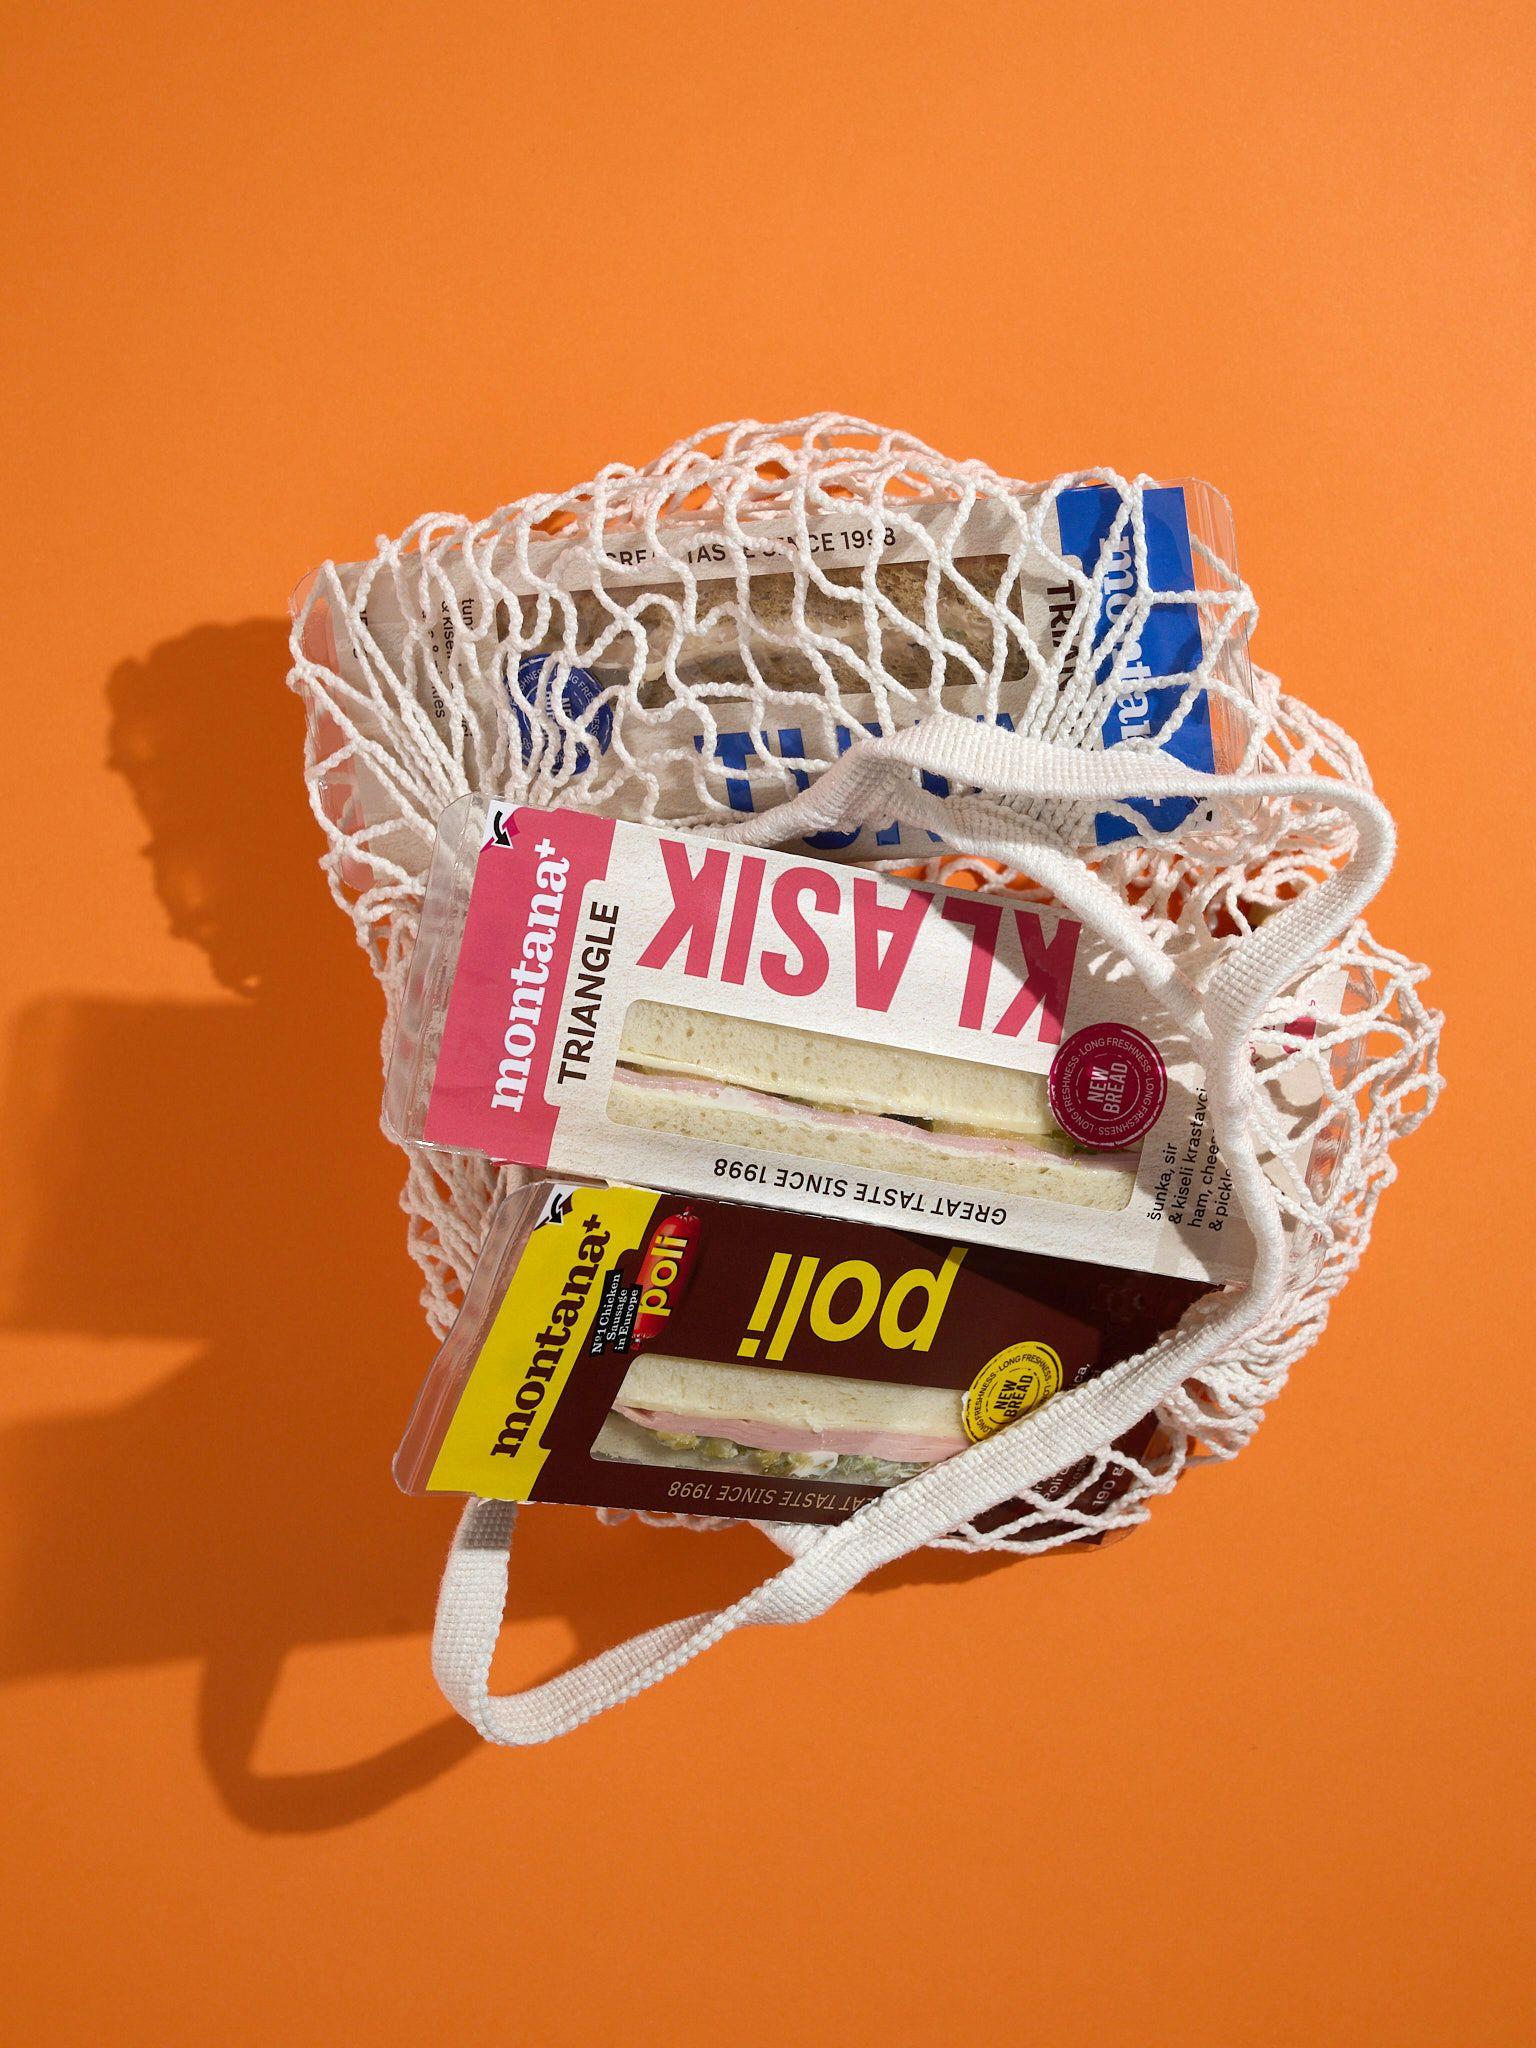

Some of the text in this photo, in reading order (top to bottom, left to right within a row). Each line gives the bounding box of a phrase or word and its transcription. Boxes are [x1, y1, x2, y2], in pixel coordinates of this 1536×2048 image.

[461, 598, 475, 634] tun
[635, 838, 1082, 1045] KLASIK
[557, 901, 619, 1084] TRIANGLE
[1079, 1037, 1152, 1073] LONG FRESHNESS
[1061, 1055, 1095, 1133] LONG FRESHNESS
[1087, 1066, 1109, 1103] NEW
[1098, 1077, 1155, 1136] LONG FRESHNESS
[1103, 1062, 1128, 1115] BREAD
[1163, 1142, 1178, 1165] sir
[1168, 1087, 1208, 1225] & kiseli krastavci
[713, 1158, 1007, 1226] GREAT TASTE SINCE 1998
[1187, 1130, 1220, 1228] ham, chee
[1208, 1219, 1224, 1232] &
[599, 1273, 621, 1326] Chicken
[638, 1235, 688, 1317] poli
[606, 1289, 628, 1341] Sausage
[614, 1289, 639, 1351] in Europe
[737, 1246, 969, 1361] poli
[998, 1355, 1021, 1371] LONG
[1021, 1353, 1052, 1384] FRESHNESS
[974, 1372, 997, 1420] FRESHNESS
[993, 1380, 1018, 1410] NEW
[1003, 1374, 1034, 1418] BREAD
[667, 1481, 713, 1499] 1998
[716, 1485, 778, 1505] SINCE
[779, 1490, 836, 1511] TASTE
[1092, 1480, 1115, 1506] 190
